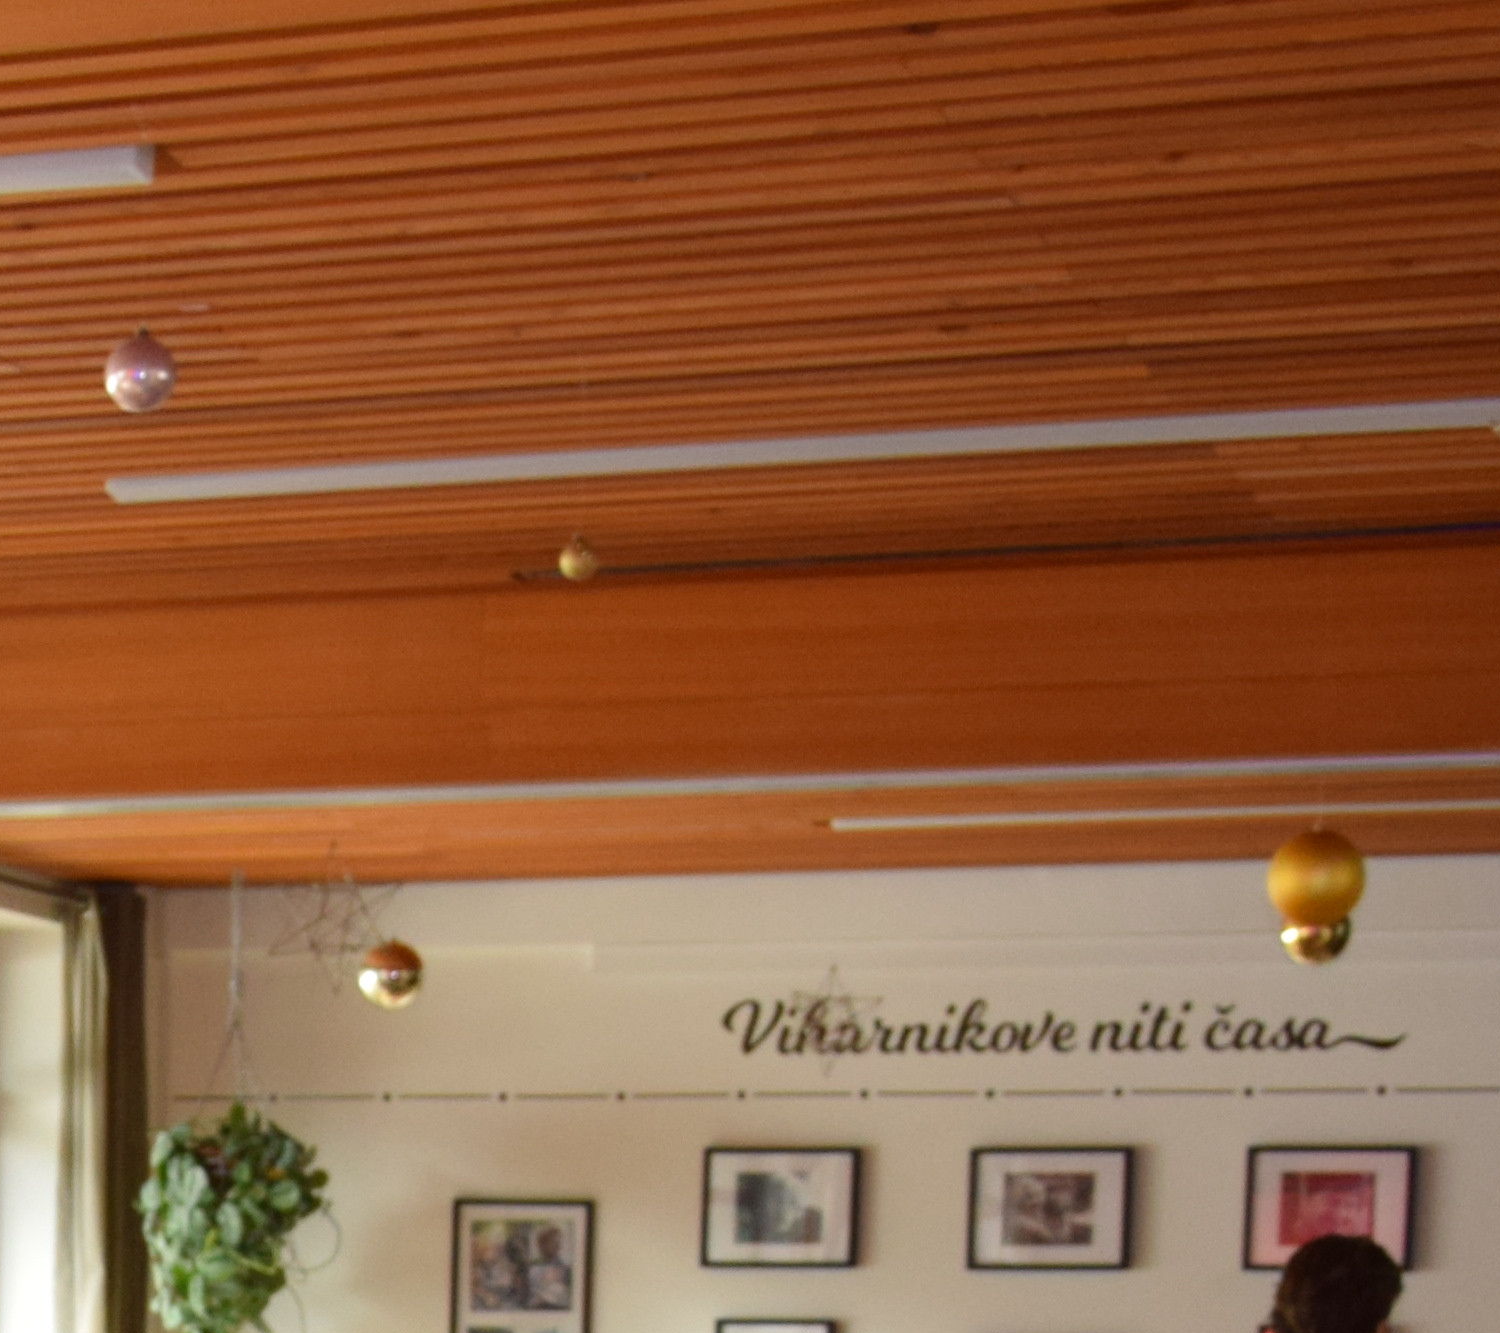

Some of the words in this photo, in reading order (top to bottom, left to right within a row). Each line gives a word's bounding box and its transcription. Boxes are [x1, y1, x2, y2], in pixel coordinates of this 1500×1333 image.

[721, 997, 1078, 1055] Viharnikove
[1089, 1000, 1194, 1054] niti
[1203, 1003, 1406, 1054] časa
